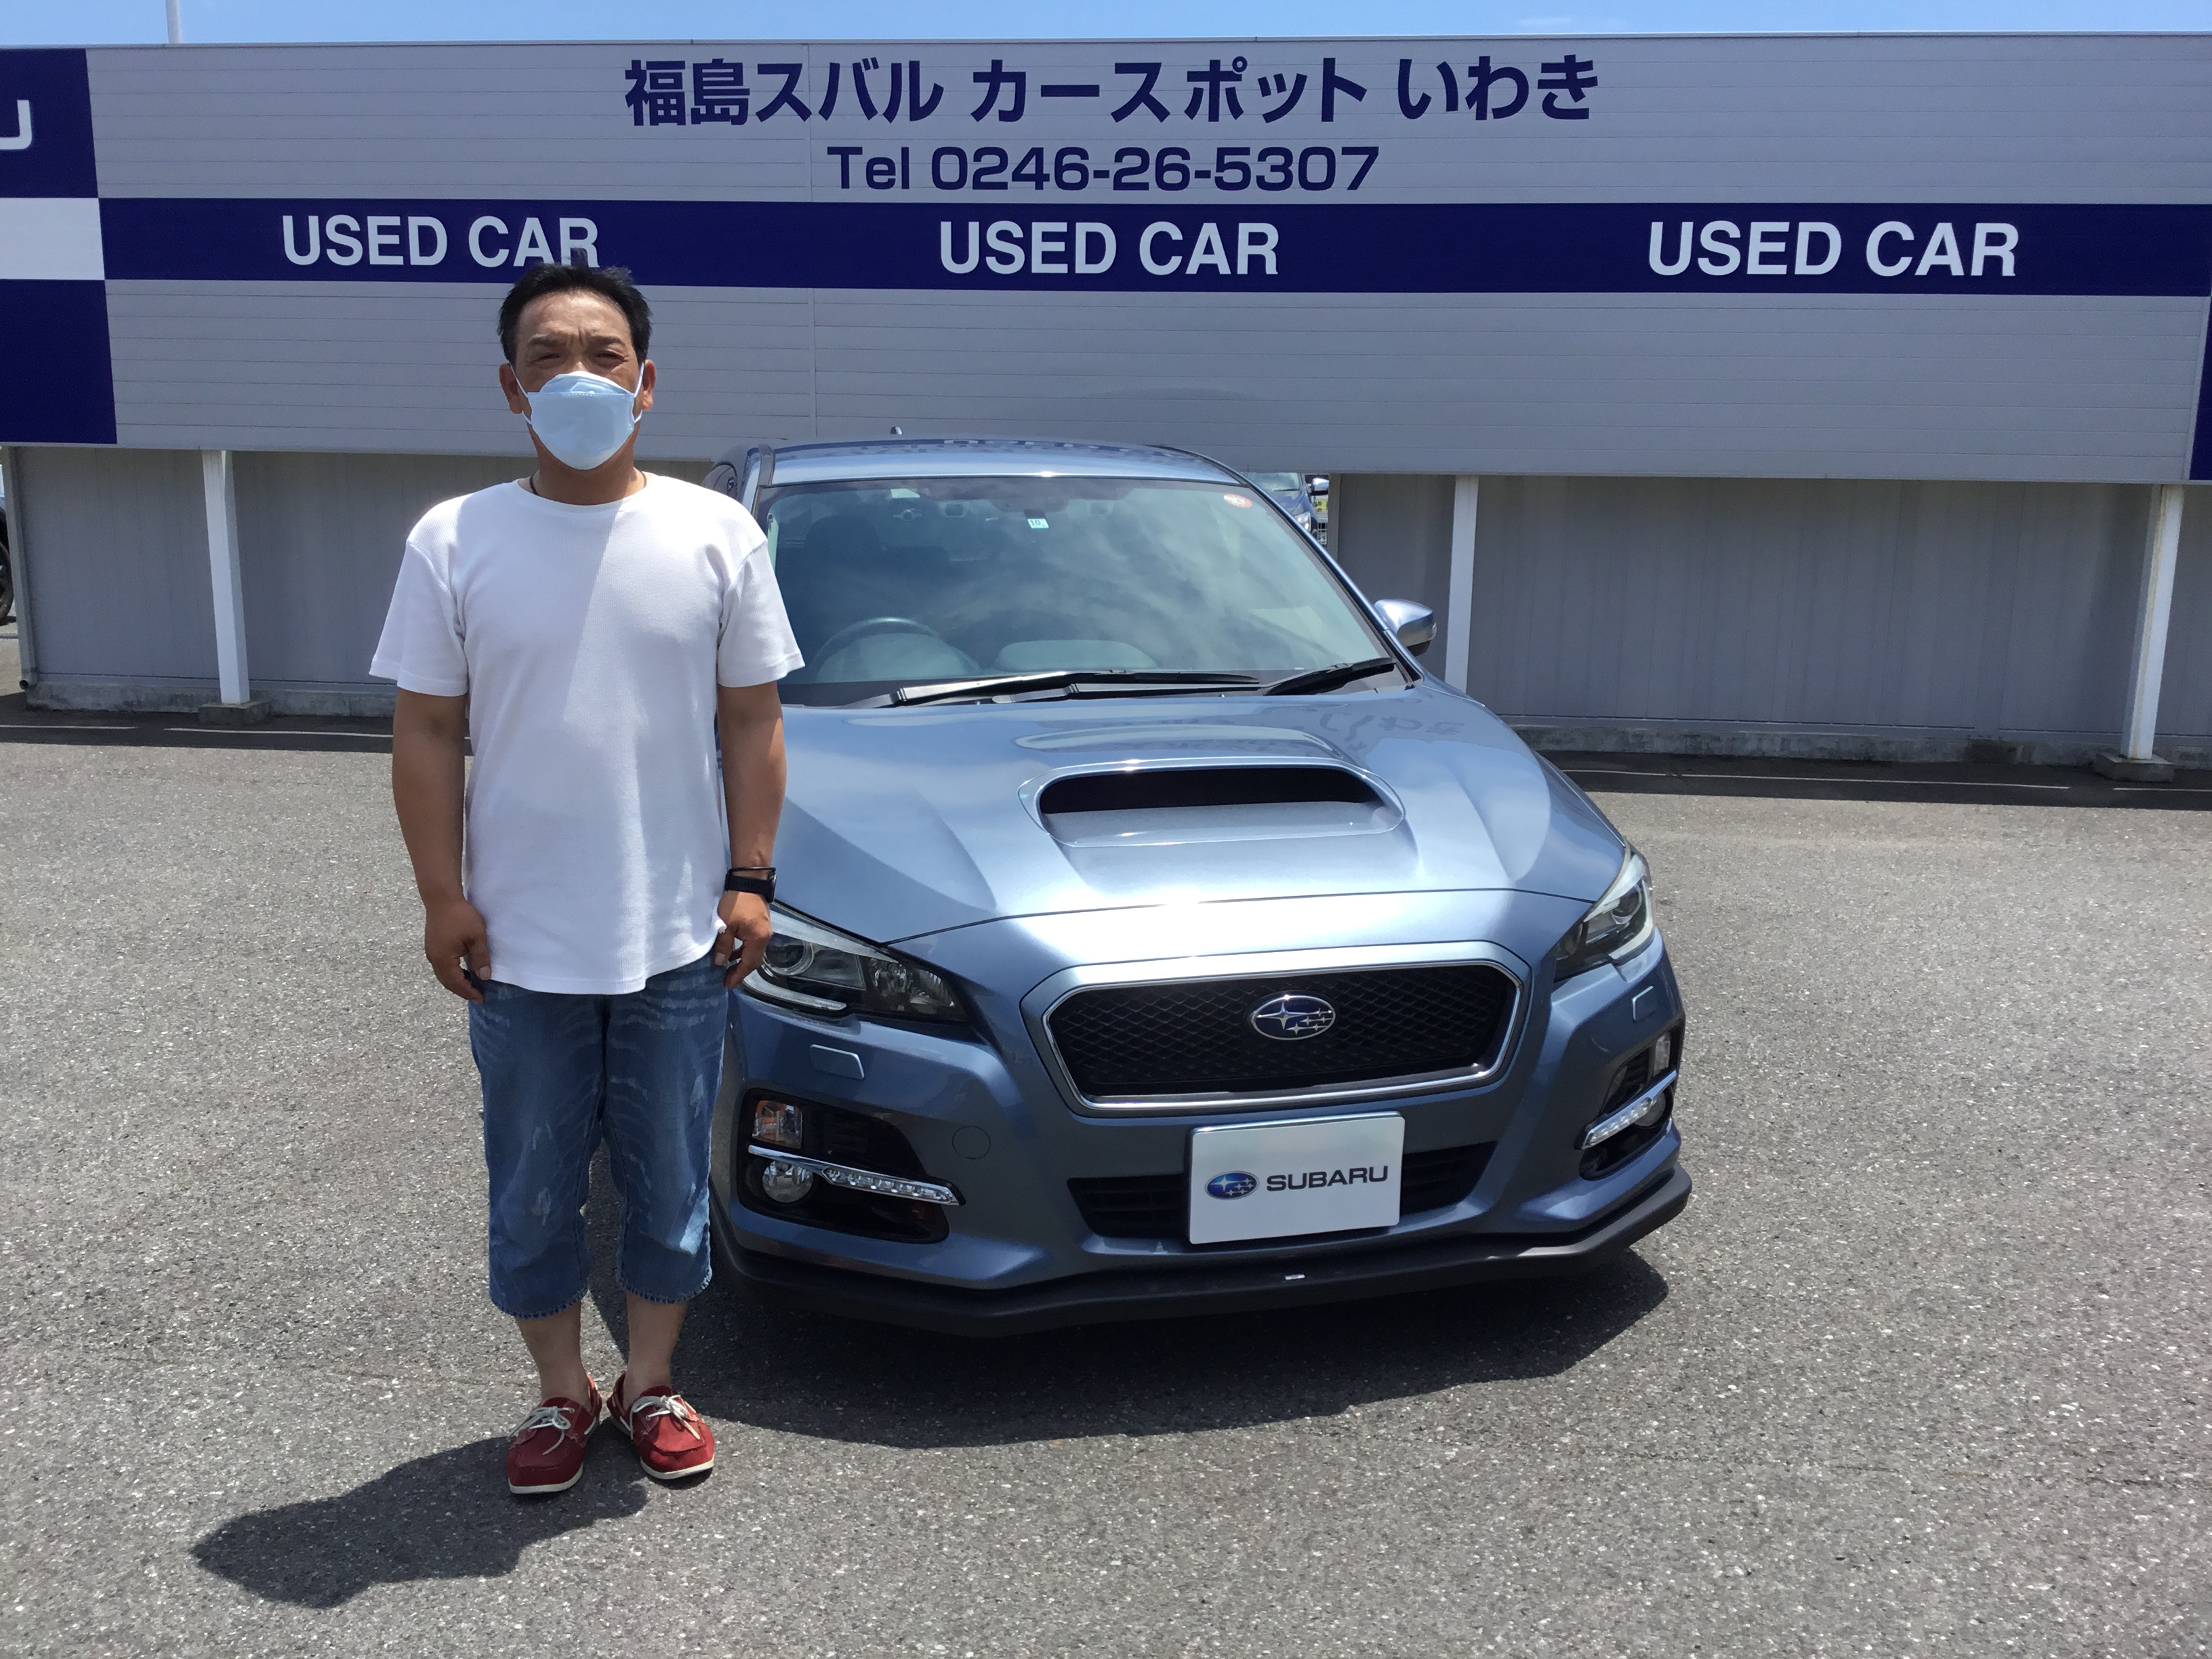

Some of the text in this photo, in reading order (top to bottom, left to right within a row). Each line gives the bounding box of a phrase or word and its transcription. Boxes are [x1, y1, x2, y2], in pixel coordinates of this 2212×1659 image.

[625, 54, 1599, 127] 福島スバル カースポット いわき
[827, 146, 1380, 192] Tel 0246-26-5307
[283, 215, 600, 268] USED CAR
[940, 221, 1279, 276] USED CAR
[1649, 220, 2020, 276] USED CAR
[1266, 1165, 1389, 1191] SUBARU
